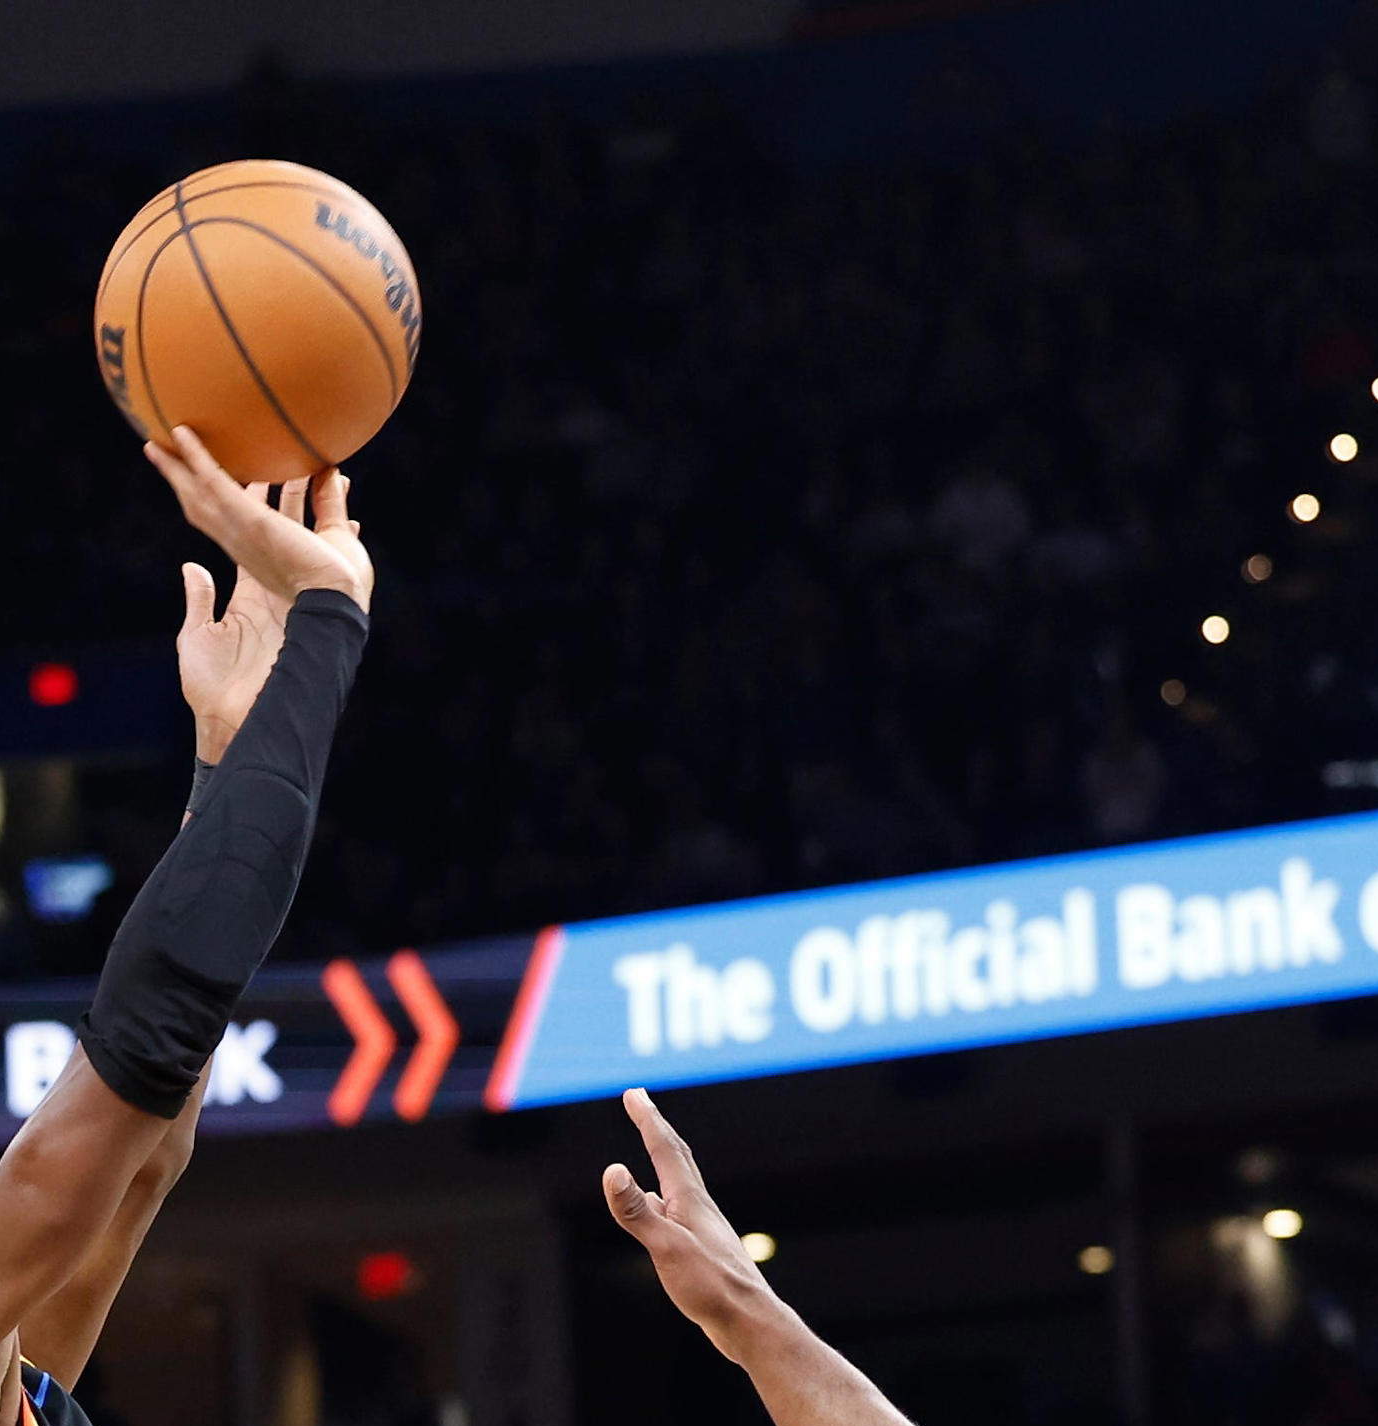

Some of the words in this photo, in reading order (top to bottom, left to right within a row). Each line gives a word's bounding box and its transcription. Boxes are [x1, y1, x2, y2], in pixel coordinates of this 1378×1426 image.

[613, 943, 776, 1056] The
[789, 887, 1097, 1033] Official
[1116, 856, 1344, 990] Bank
[4, 1018, 283, 1119] BK
